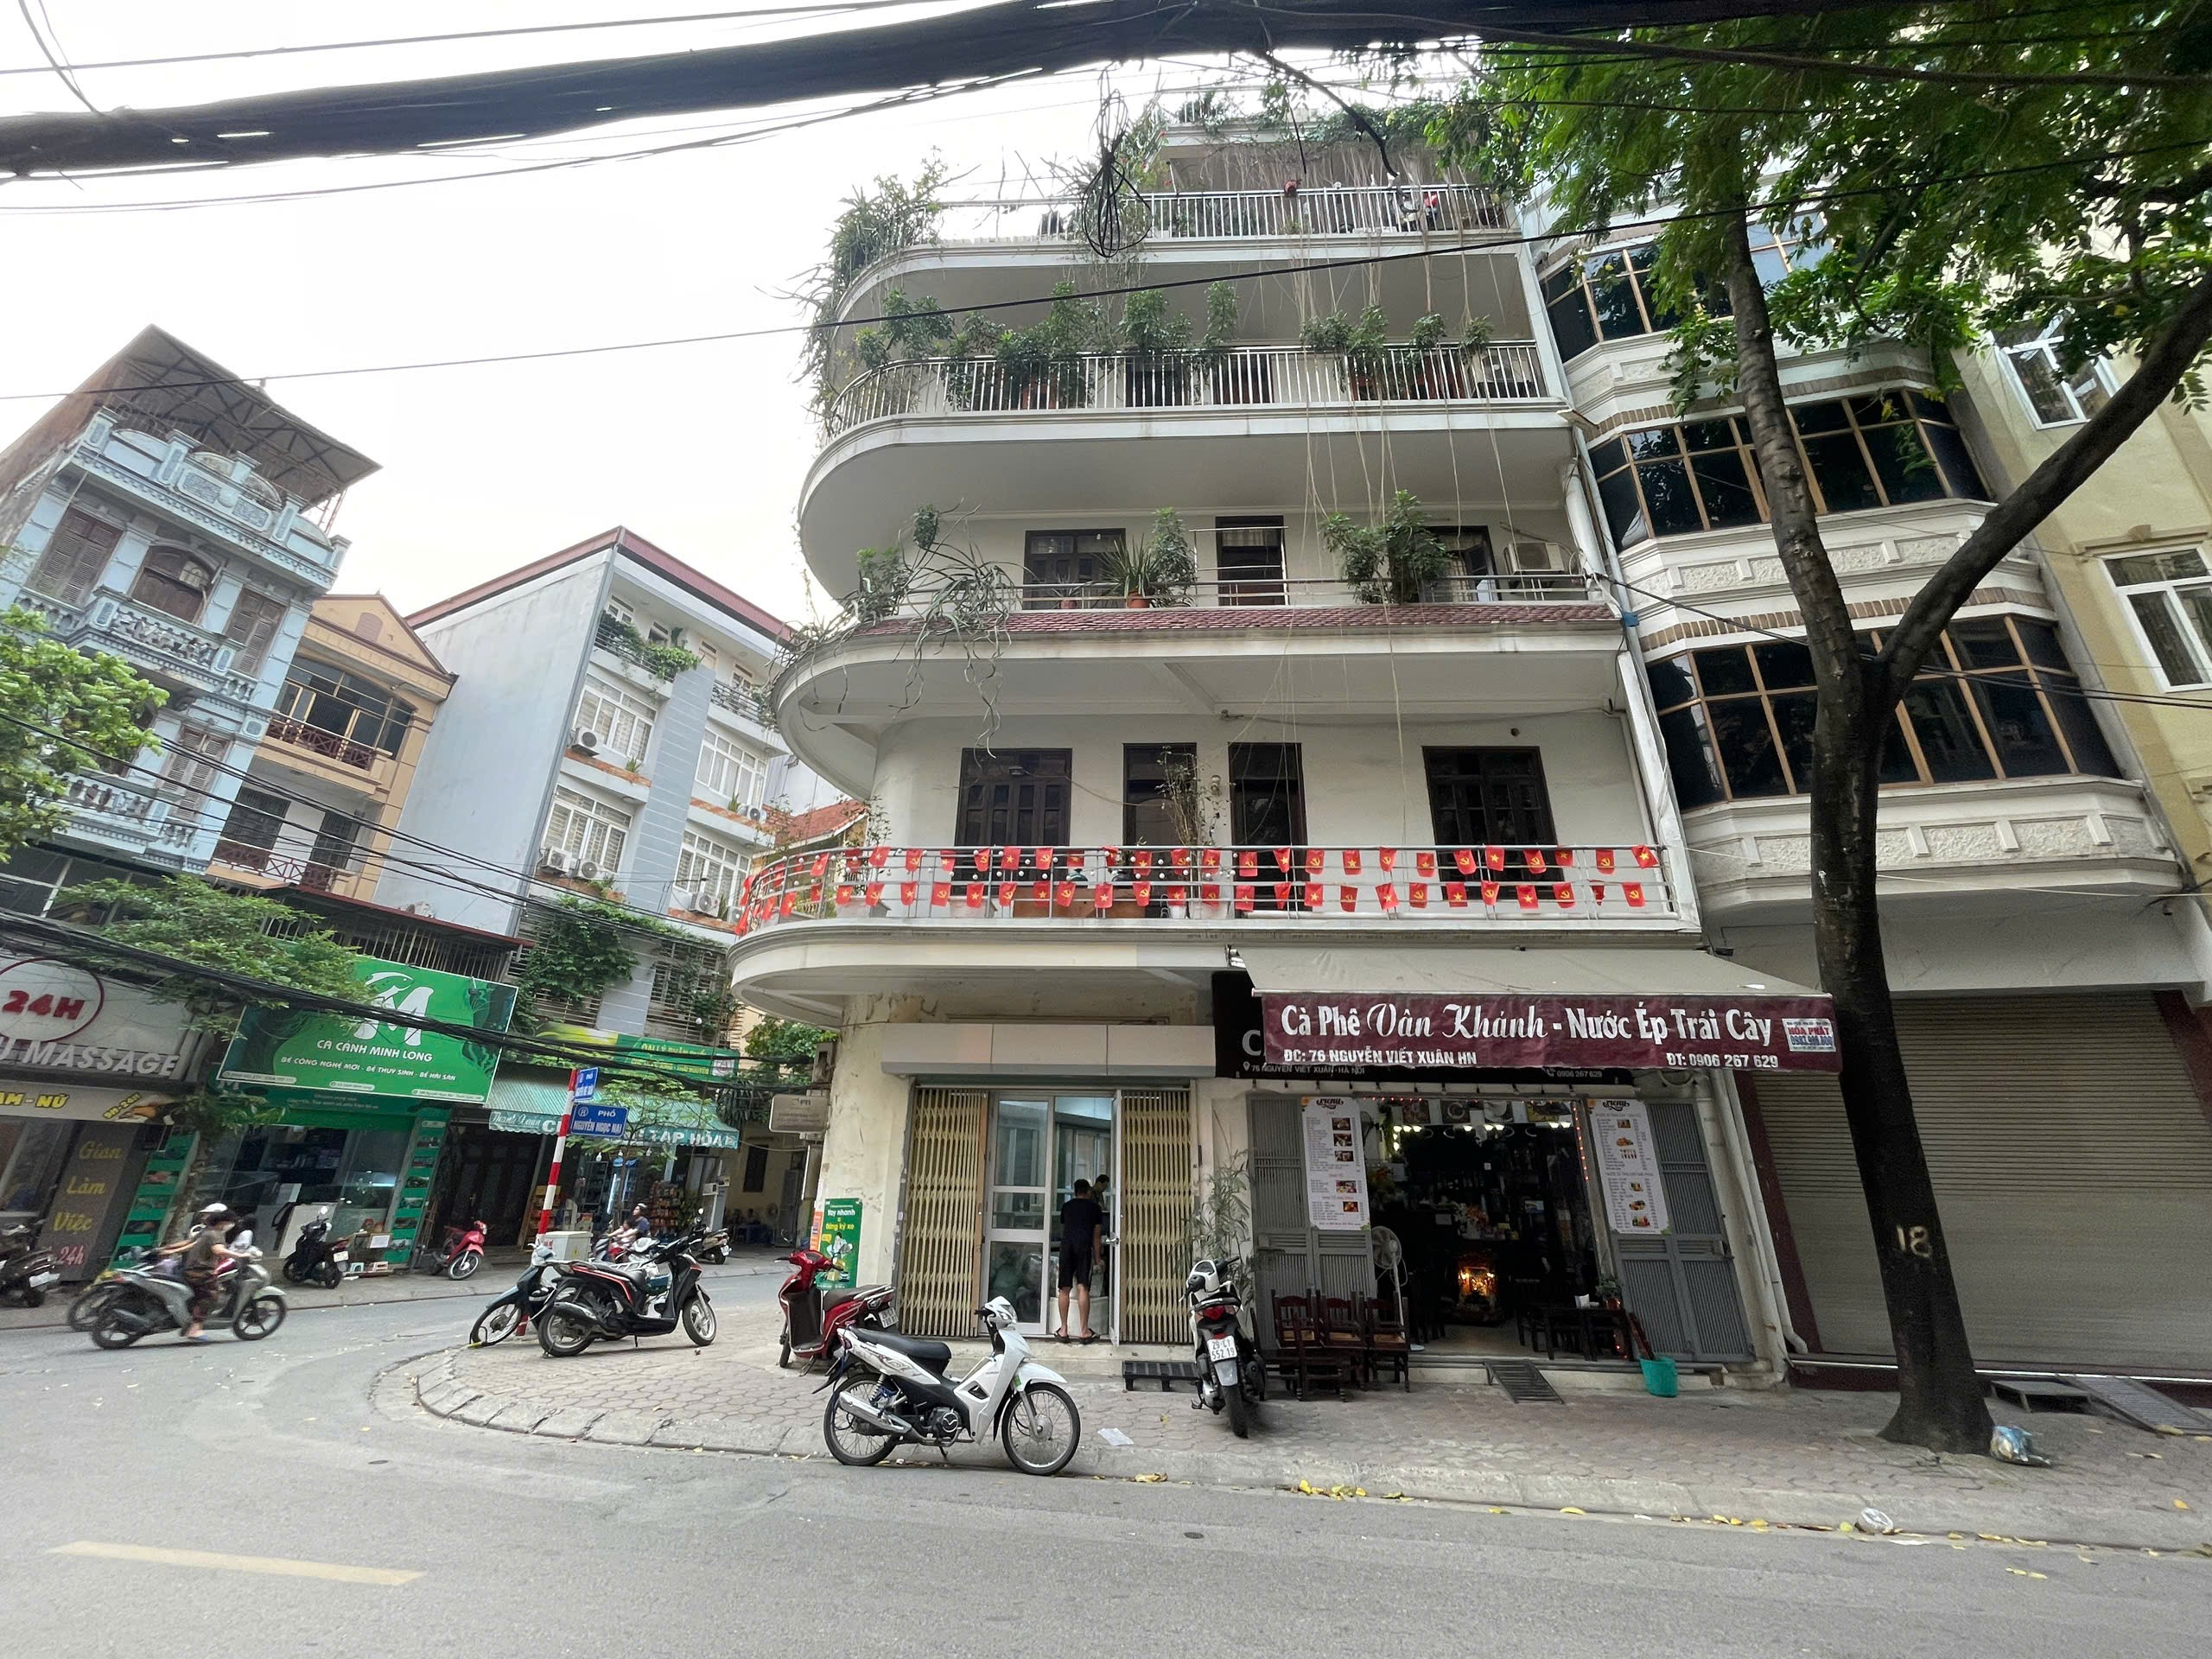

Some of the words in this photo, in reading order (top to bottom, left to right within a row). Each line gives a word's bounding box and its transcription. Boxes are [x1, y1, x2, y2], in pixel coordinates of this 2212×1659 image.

[2, 990, 86, 1020] 24H
[1281, 1004, 1311, 1036] Cà
[1317, 1005, 1360, 1036] Phê
[1367, 1003, 1434, 1037] Vân
[1441, 1003, 1548, 1039] Khánh
[1565, 1007, 1632, 1039] Nước
[1634, 1001, 1668, 1045] Ép
[1669, 1008, 1720, 1039] Trái
[1726, 1008, 1771, 1046] Cây
[22, 1040, 181, 1077] MASSAGE
[369, 1046, 400, 1058] MINH
[402, 1050, 433, 1062] LONG
[1284, 1049, 1306, 1063] ĐC:
[1309, 1049, 1325, 1063] 76
[1329, 1046, 1382, 1064] NGUYỄN
[1385, 1047, 1414, 1064] VIẾT
[1417, 1049, 1454, 1065] XUÂN
[1458, 1052, 1478, 1065] HN
[1666, 1052, 1687, 1066] ĐT:
[1688, 1053, 1720, 1067] 0906
[1724, 1054, 1749, 1067] 267
[1753, 1054, 1778, 1068] 629
[35, 1093, 70, 1109] NỮ
[598, 1109, 616, 1117] PHỐ
[1897, 1224, 1933, 1258] 18
